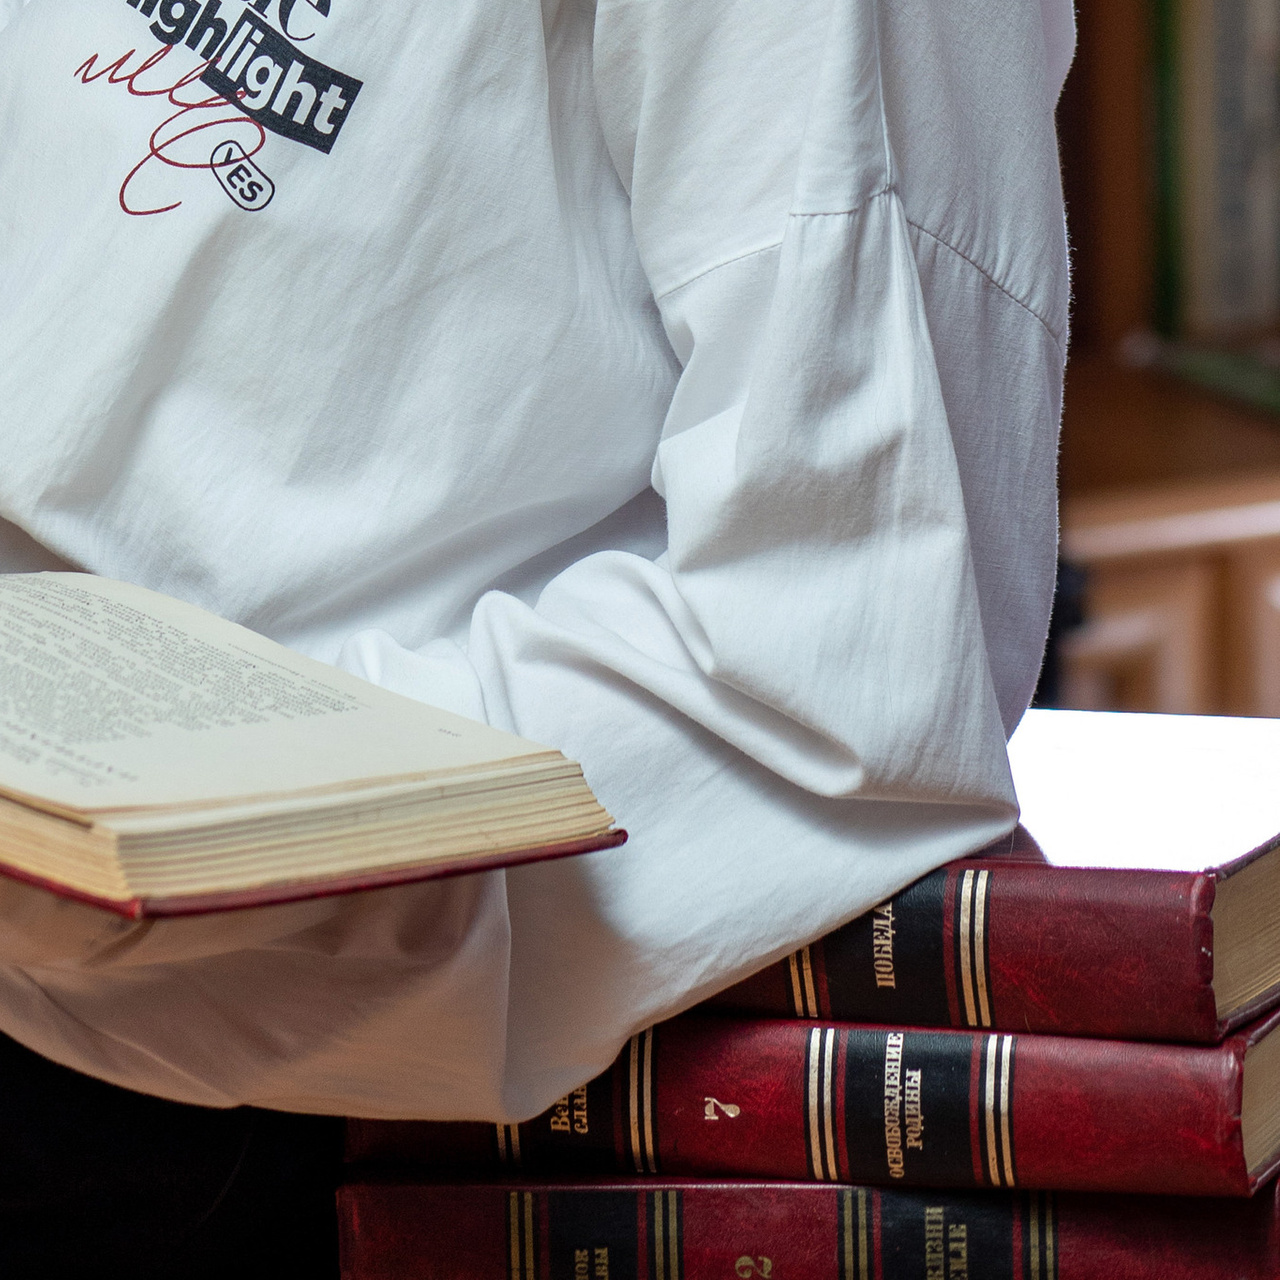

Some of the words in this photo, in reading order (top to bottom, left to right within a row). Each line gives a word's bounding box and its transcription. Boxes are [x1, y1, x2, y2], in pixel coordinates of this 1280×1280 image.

[221, 148, 264, 203] YES
[872, 901, 897, 990] ПОБЕДА
[573, 1083, 589, 1134] слав
[704, 1096, 740, 1121] 7
[883, 1032, 904, 1178] ОСВОБОЖДЕНИЕ
[905, 1068, 924, 1150] РОДИНЫ
[734, 1255, 772, 1279] 2
